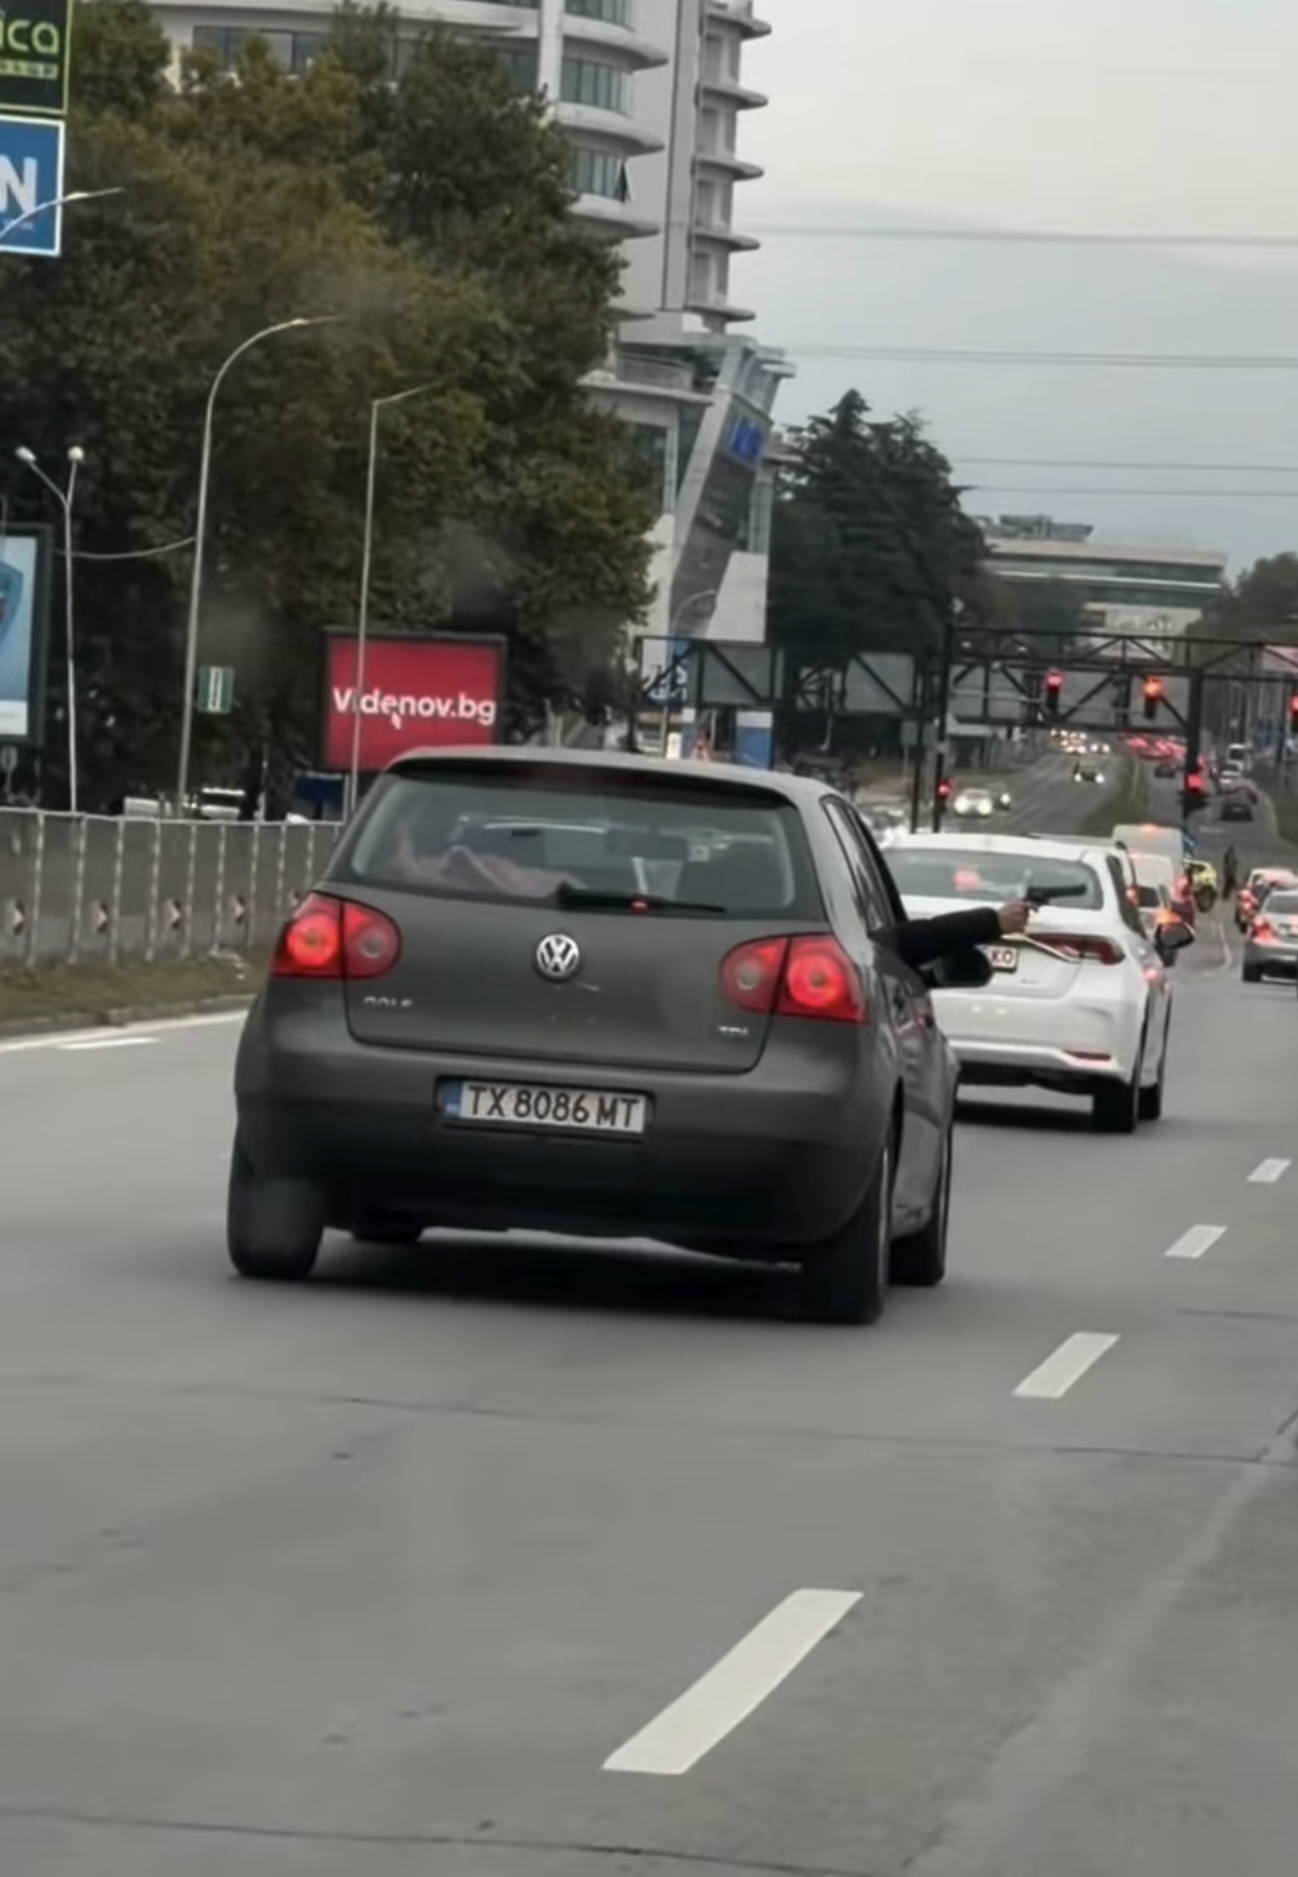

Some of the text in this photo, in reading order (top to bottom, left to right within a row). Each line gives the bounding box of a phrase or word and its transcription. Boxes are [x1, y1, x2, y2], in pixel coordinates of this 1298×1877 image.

[333, 687, 496, 725] Videnov.bg
[468, 1085, 507, 1117] TX
[514, 1089, 589, 1123] 8086
[596, 1096, 641, 1128] MT
